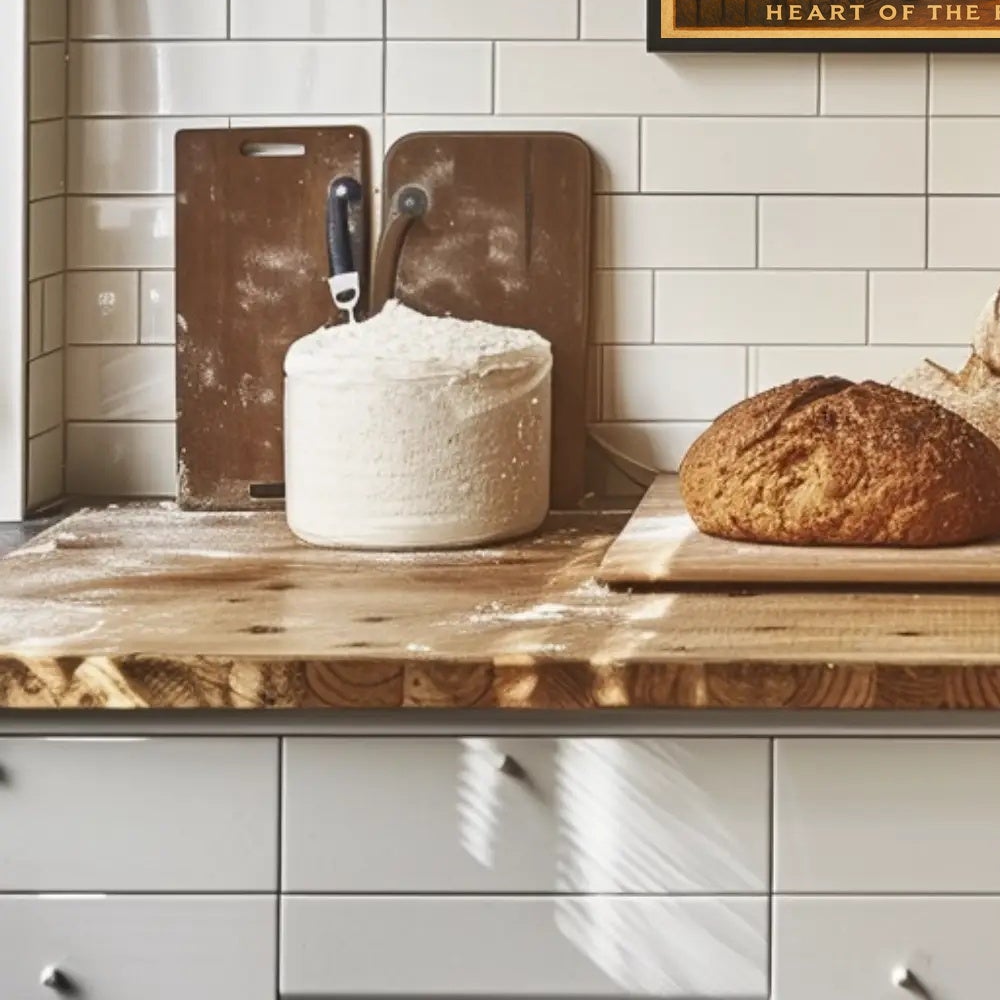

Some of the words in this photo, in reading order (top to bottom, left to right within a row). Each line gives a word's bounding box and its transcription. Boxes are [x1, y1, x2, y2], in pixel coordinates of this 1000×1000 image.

[766, 4, 865, 21] HEART
[878, 4, 915, 21] OF
[928, 4, 980, 21] THE
